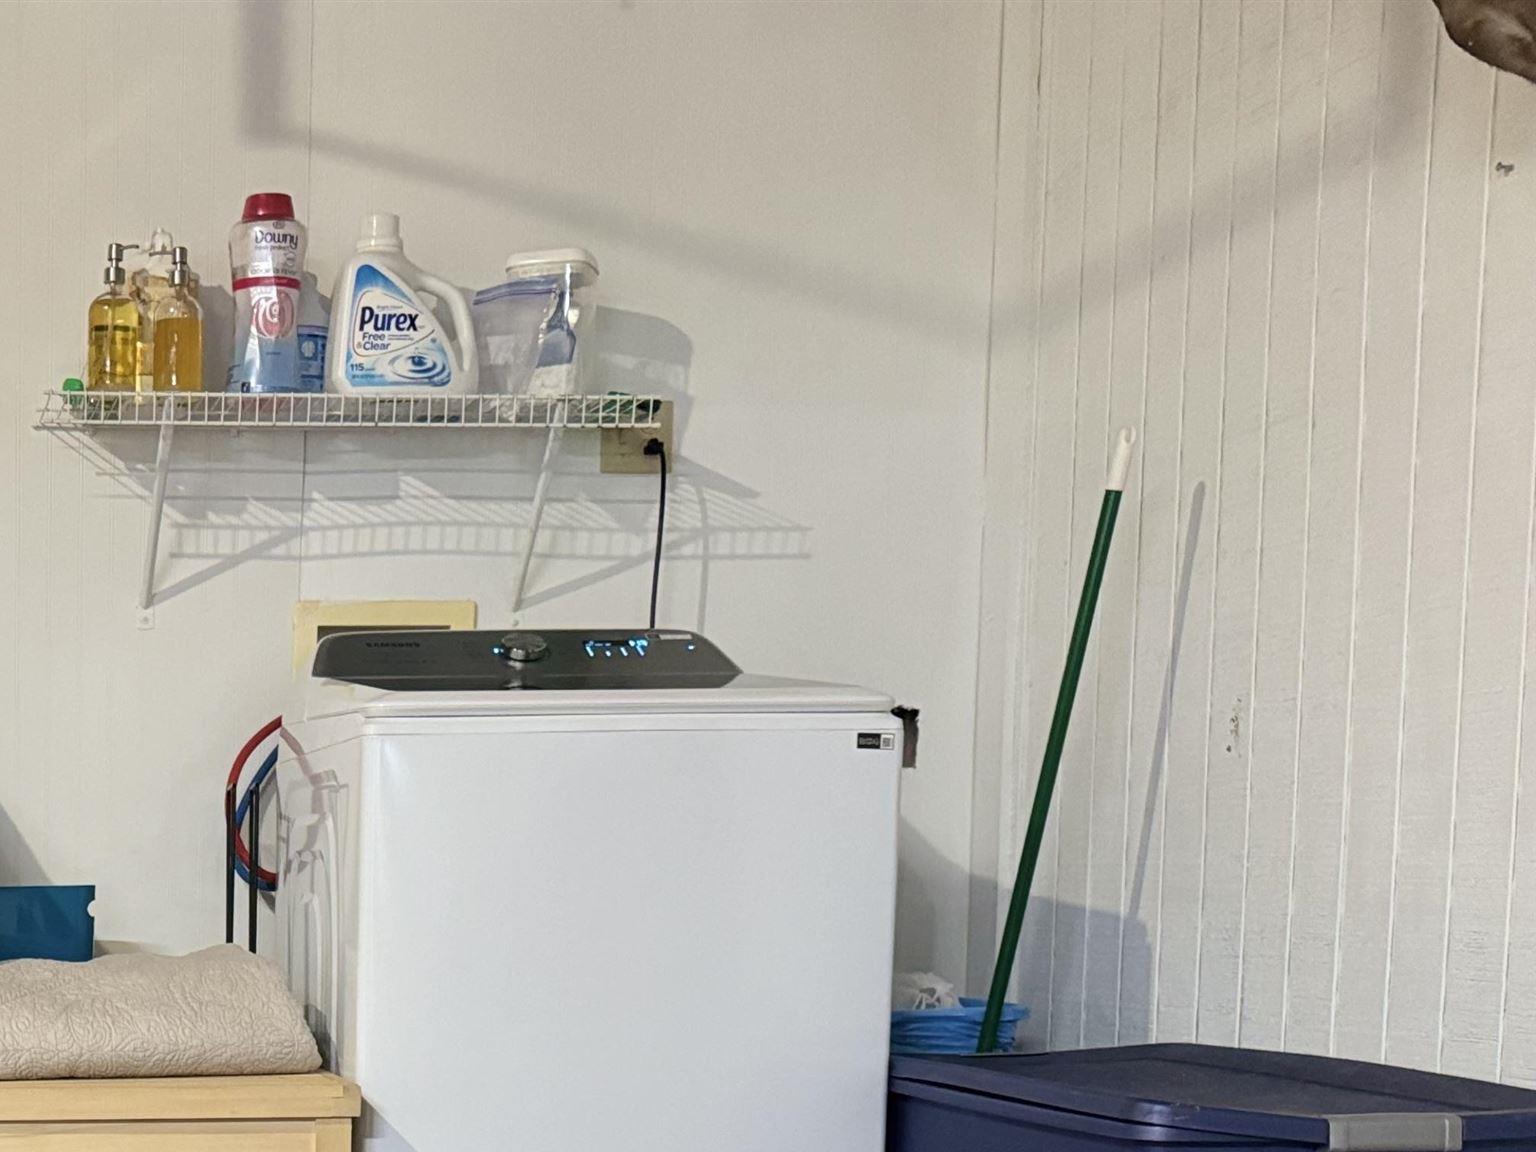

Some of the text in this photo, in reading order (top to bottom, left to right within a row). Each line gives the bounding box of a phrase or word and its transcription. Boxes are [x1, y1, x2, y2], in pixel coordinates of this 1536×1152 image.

[254, 230, 298, 250] Downy
[358, 306, 419, 332] Purex
[362, 332, 386, 341] Free
[362, 341, 391, 351] Clear
[350, 363, 364, 372] 115
